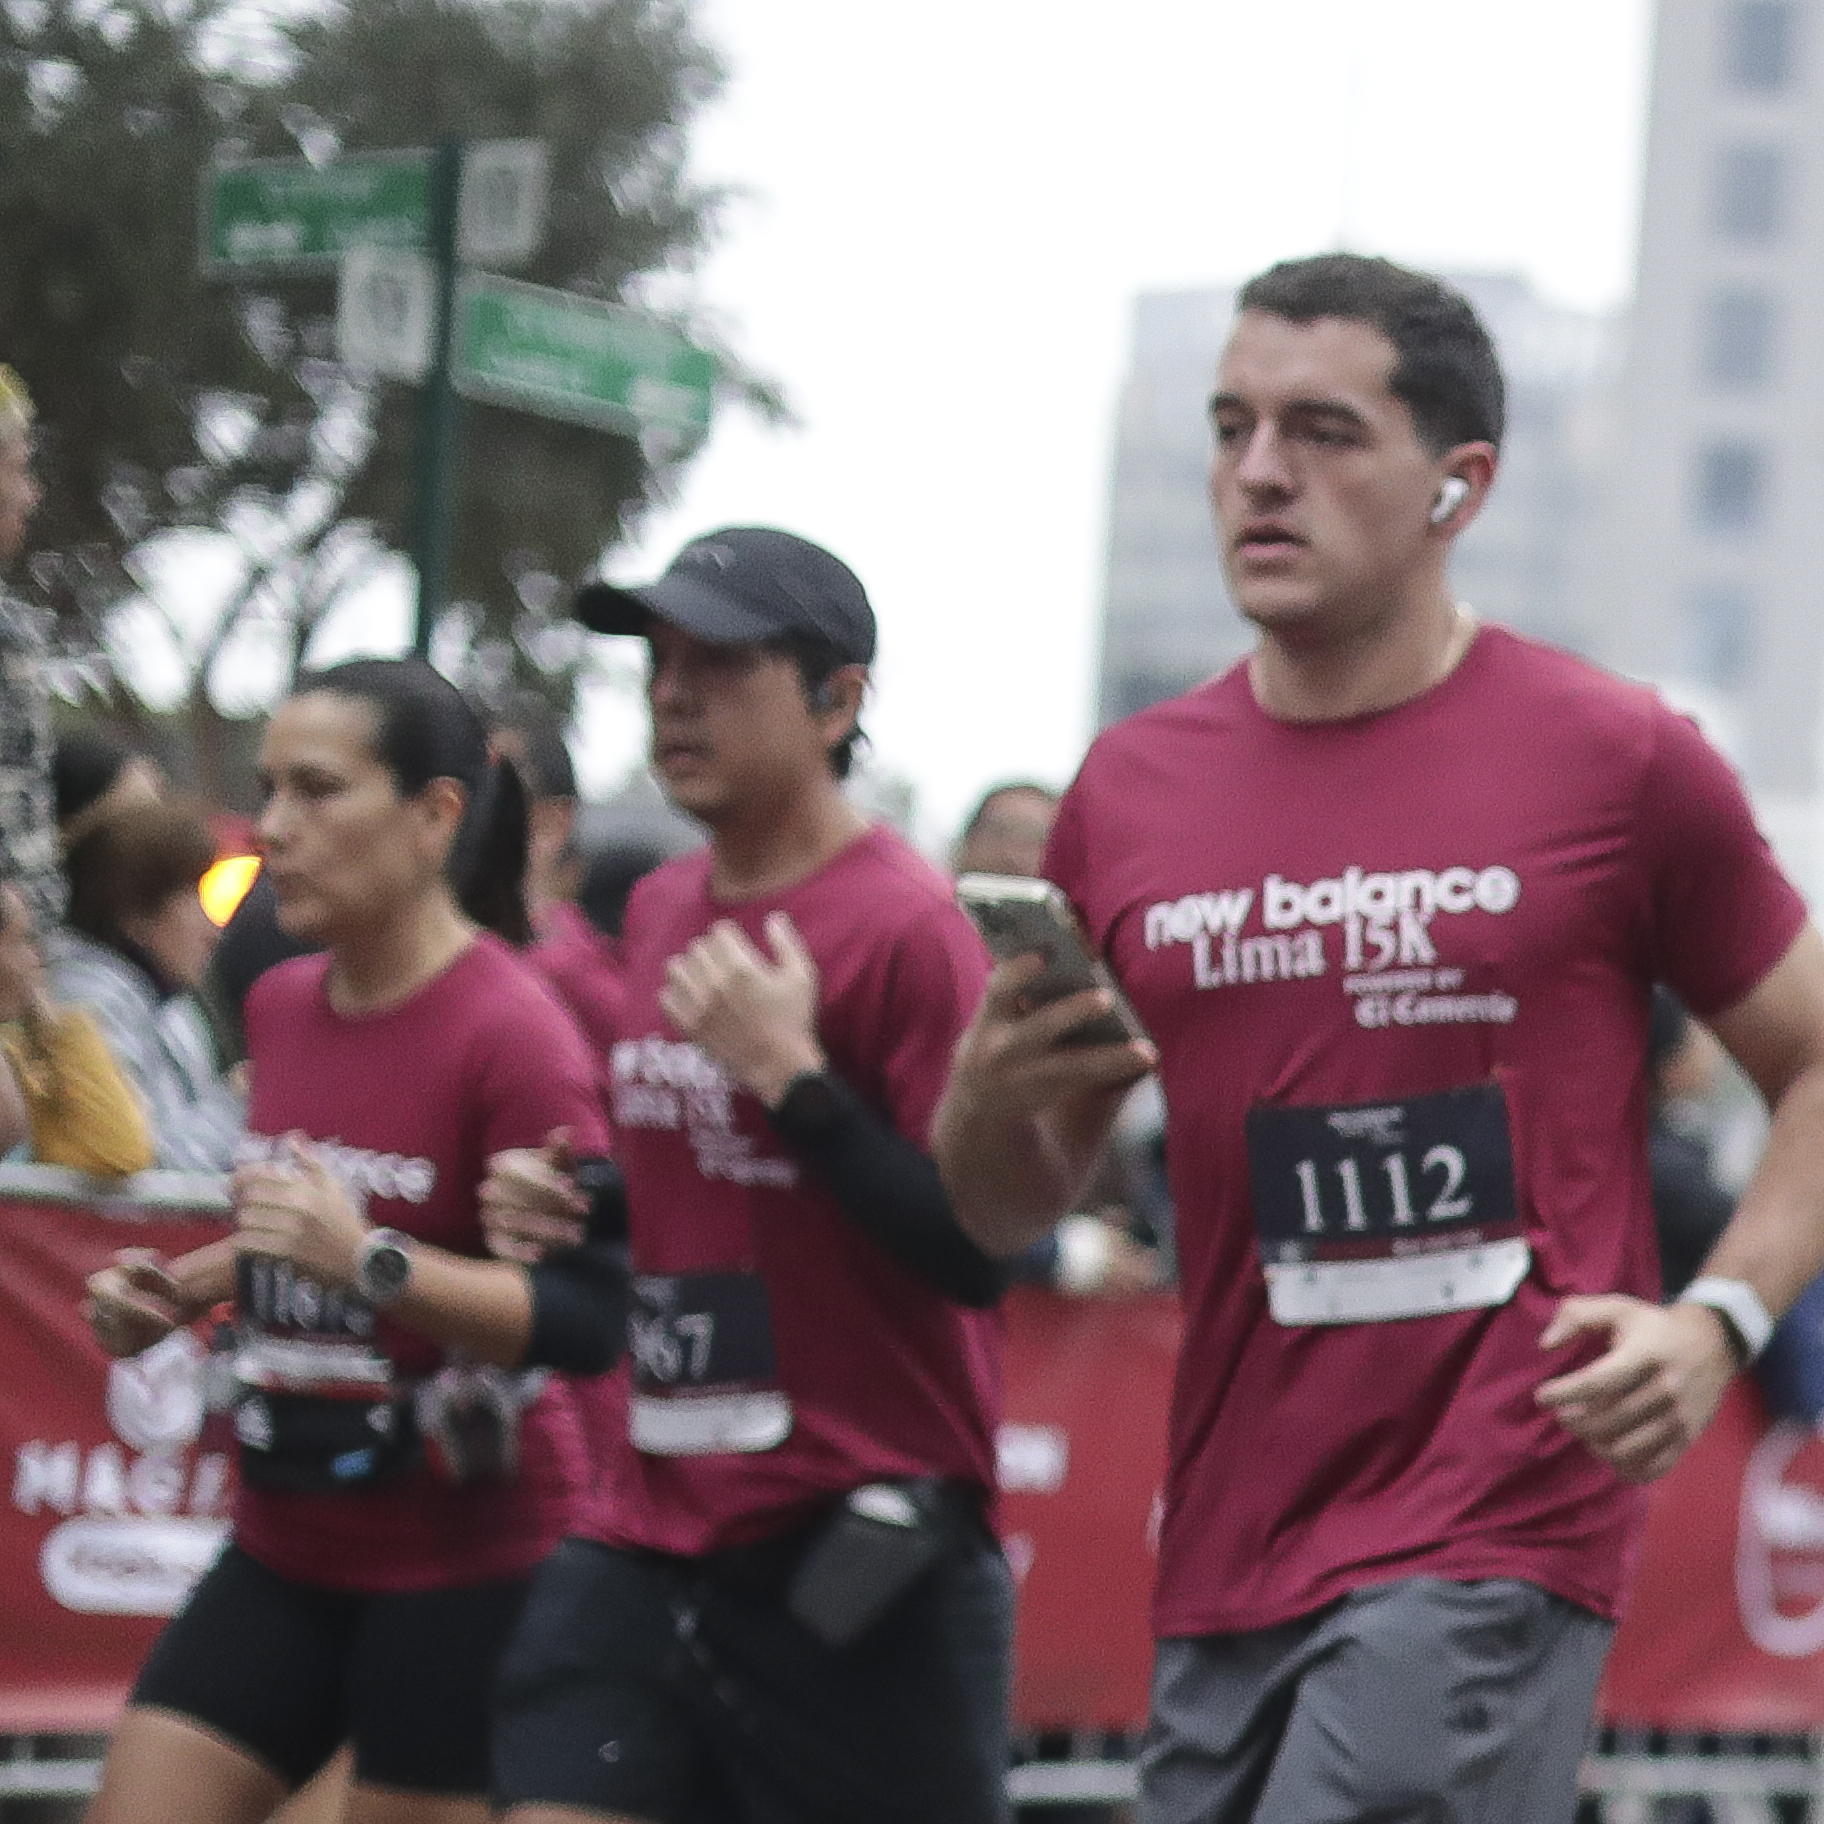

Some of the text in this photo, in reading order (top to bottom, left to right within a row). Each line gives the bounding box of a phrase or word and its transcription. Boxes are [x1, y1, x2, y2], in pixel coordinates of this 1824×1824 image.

[1262, 865, 1520, 930] balance
[1194, 928, 1326, 991] Lima
[1342, 908, 1438, 974] 15K
[1296, 1144, 1474, 1232] 1112
